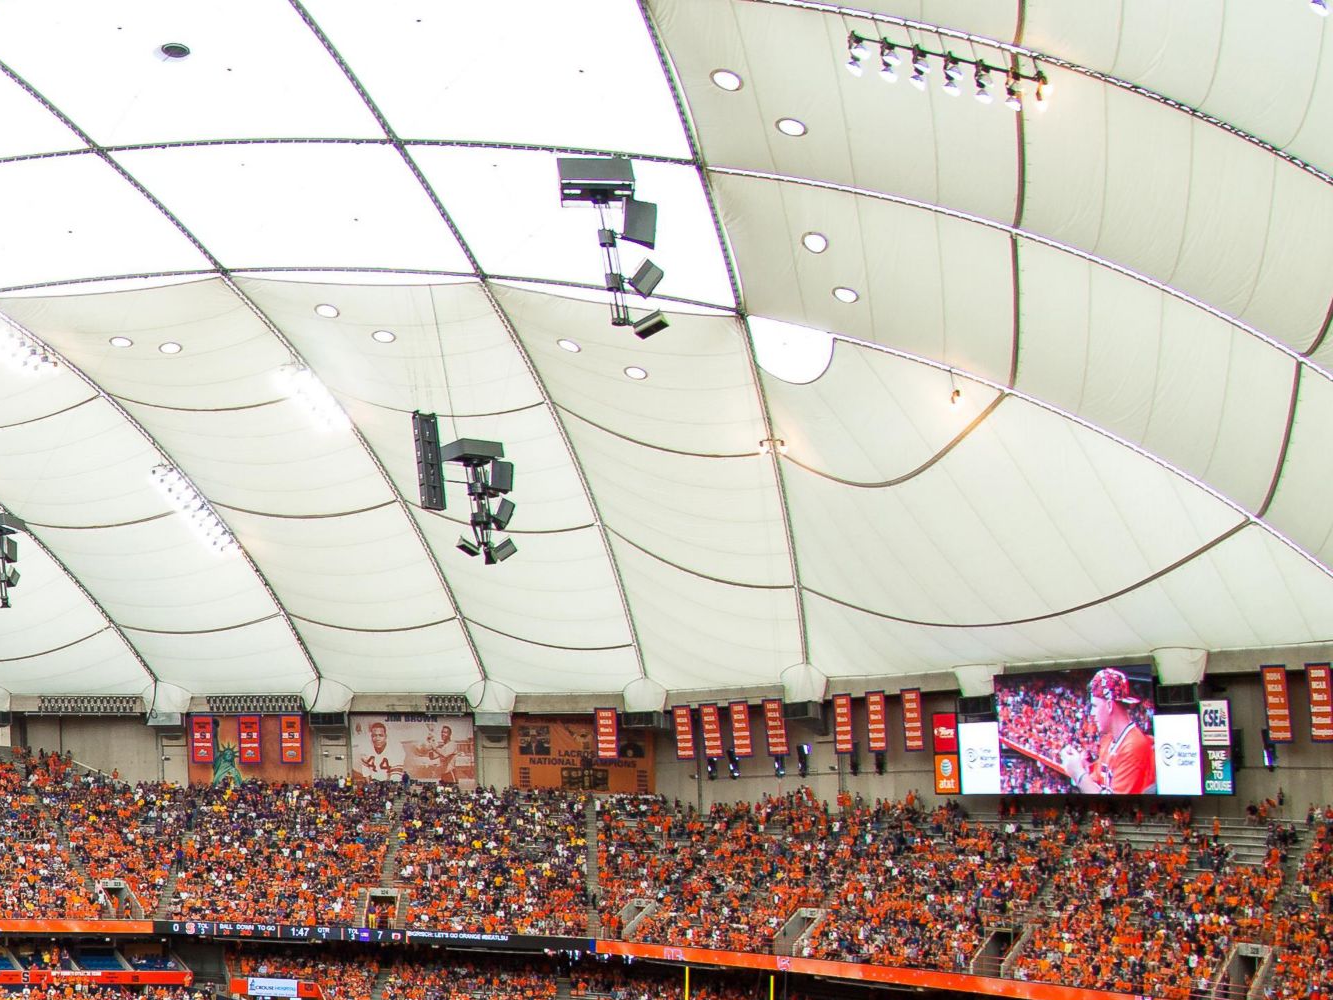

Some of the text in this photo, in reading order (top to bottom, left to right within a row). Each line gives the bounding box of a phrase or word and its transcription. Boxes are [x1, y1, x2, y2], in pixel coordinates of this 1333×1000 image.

[1207, 750, 1226, 760] TAKE
[1212, 761, 1224, 769] ME
[1213, 771, 1223, 780] TO
[1205, 781, 1231, 792] CROUSE
[291, 927, 310, 936] 1:47
